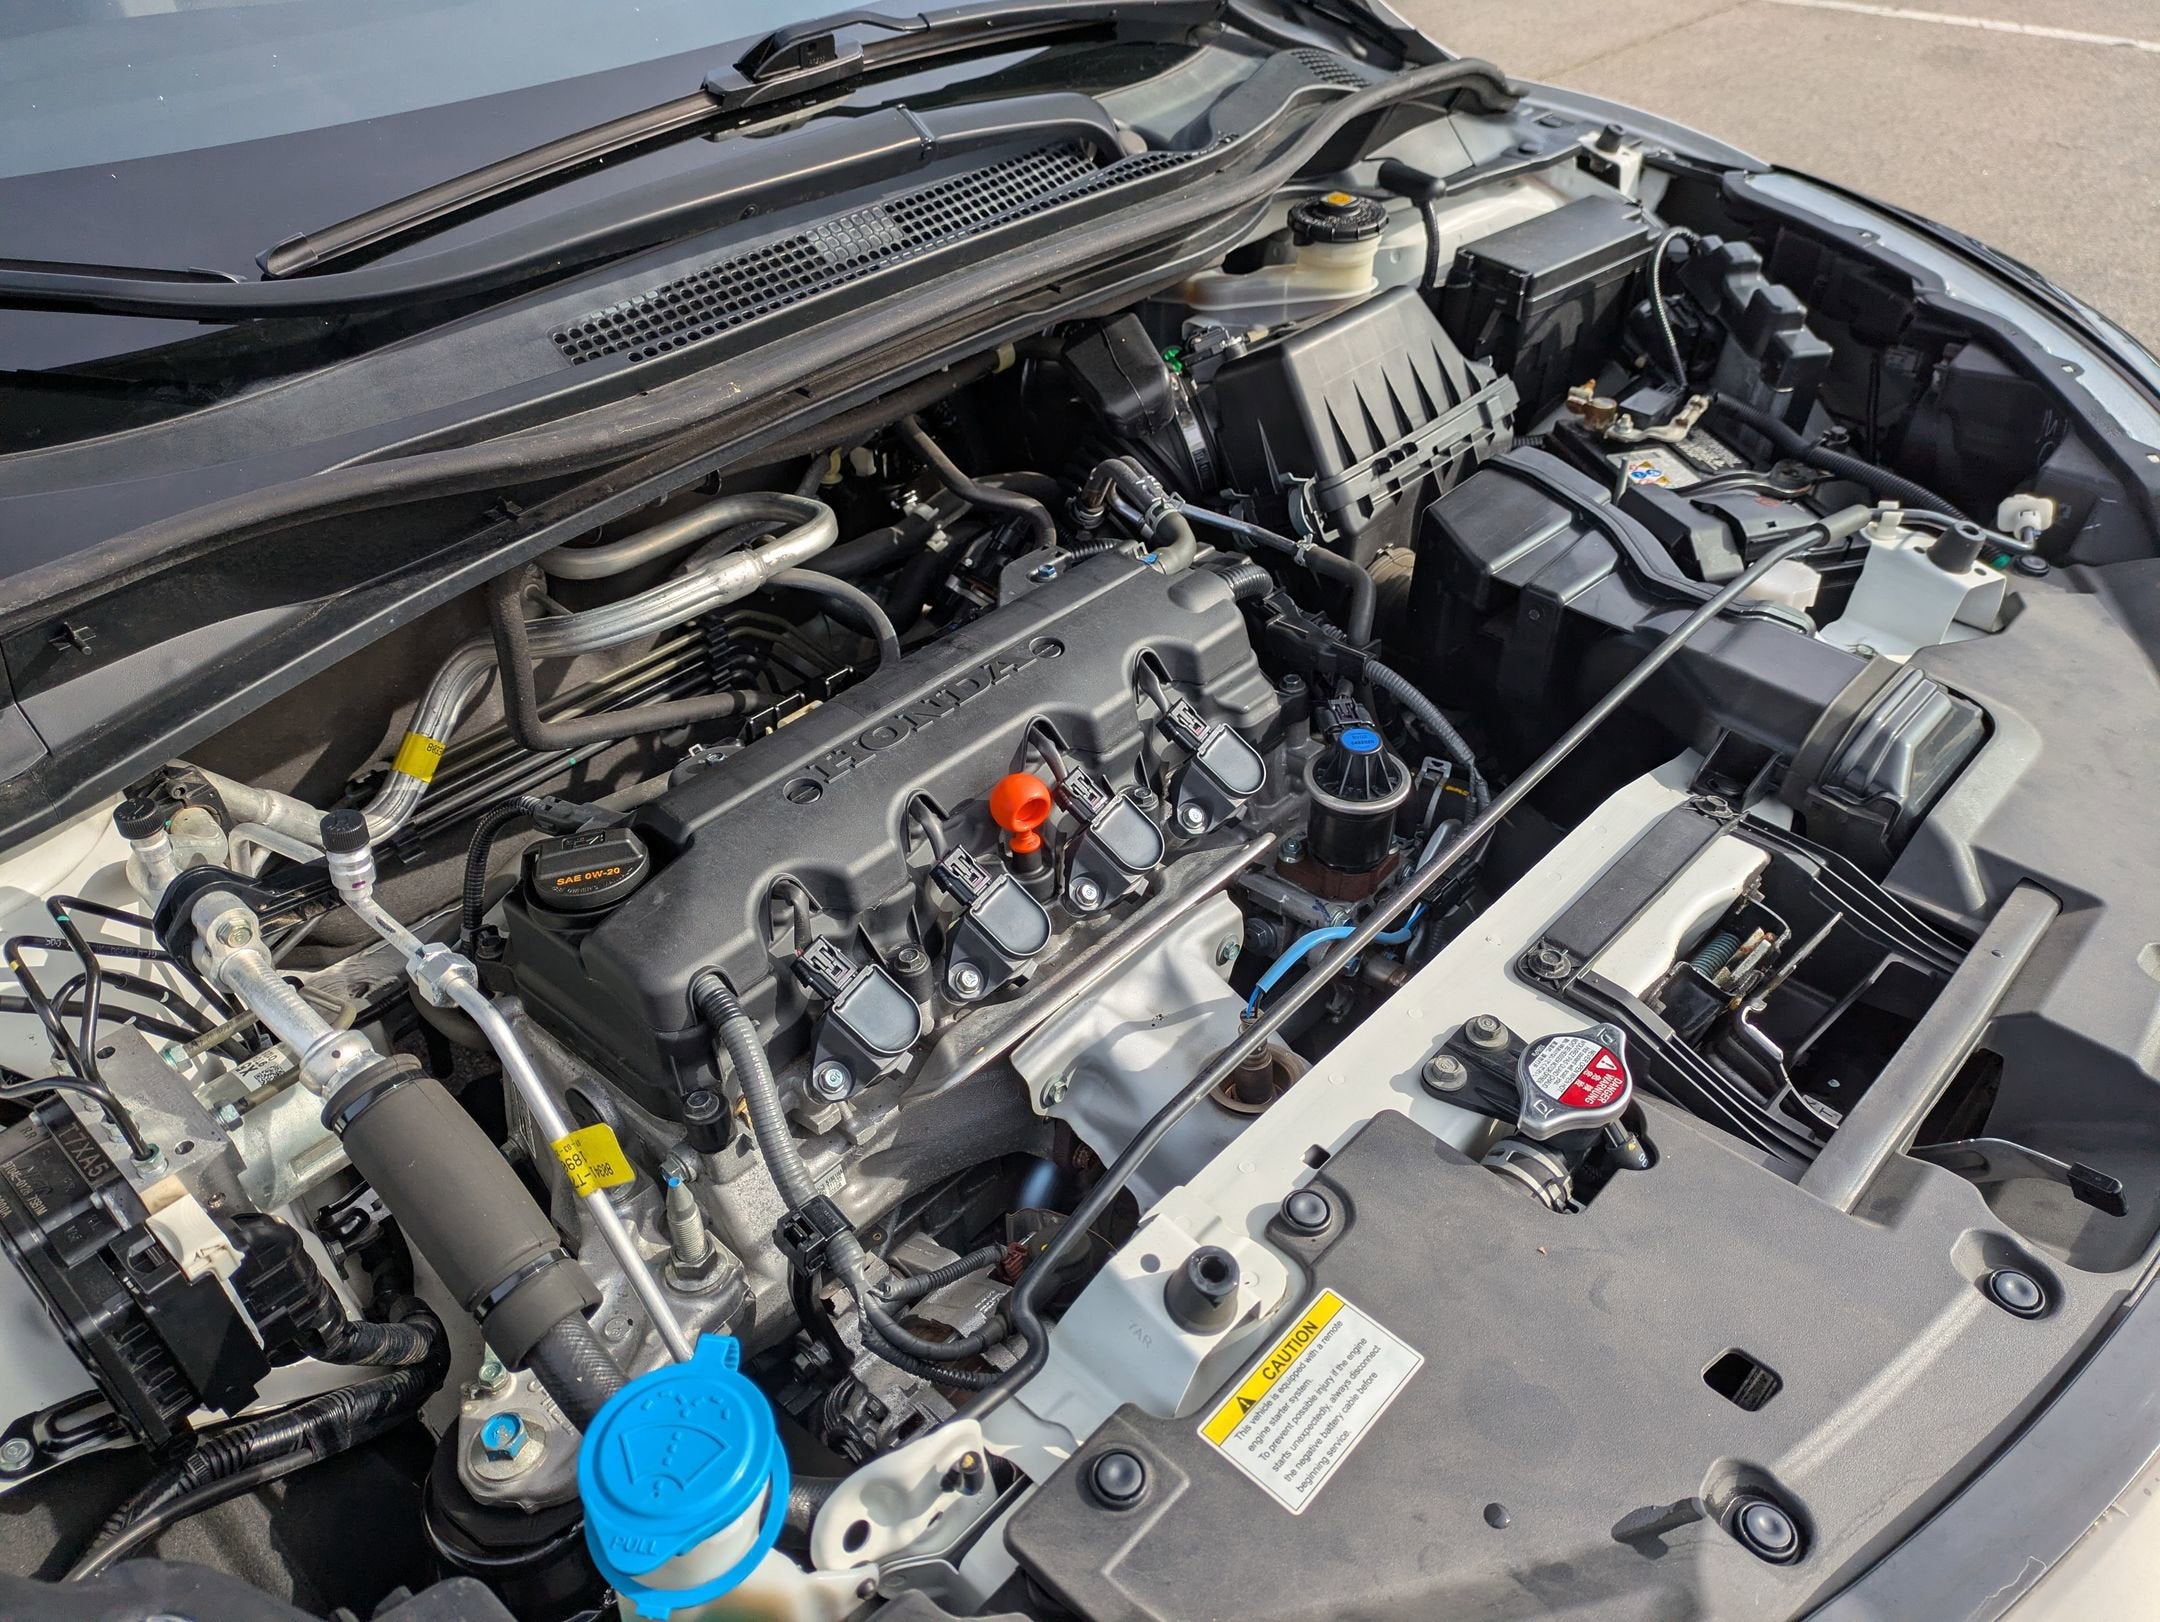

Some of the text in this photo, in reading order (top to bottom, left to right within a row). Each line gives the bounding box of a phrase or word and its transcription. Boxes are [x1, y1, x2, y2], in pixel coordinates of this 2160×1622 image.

[806, 655, 1038, 784] HONDA
[556, 873, 582, 886] SAE
[585, 866, 621, 880] 0W-20
[1573, 1061, 1586, 1075] OPEN
[1585, 1074, 1614, 1104] WARNUNG
[1597, 1078, 1623, 1103] DANGER
[58, 1121, 110, 1178] T7XA5
[1234, 1321, 1343, 1440] This vehicle is equipped with a remote
[1263, 1321, 1318, 1380] CAUTION
[1248, 1379, 1313, 1451] engine starter system.
[1257, 1338, 1367, 1461] To prevent possible injury if the engine
[1272, 1345, 1381, 1472] starts unexpectedly, always disconnect
[1283, 1372, 1378, 1483] the negative battery cable before
[1296, 1431, 1351, 1493] beginning service.
[611, 1536, 657, 1556] PULL
